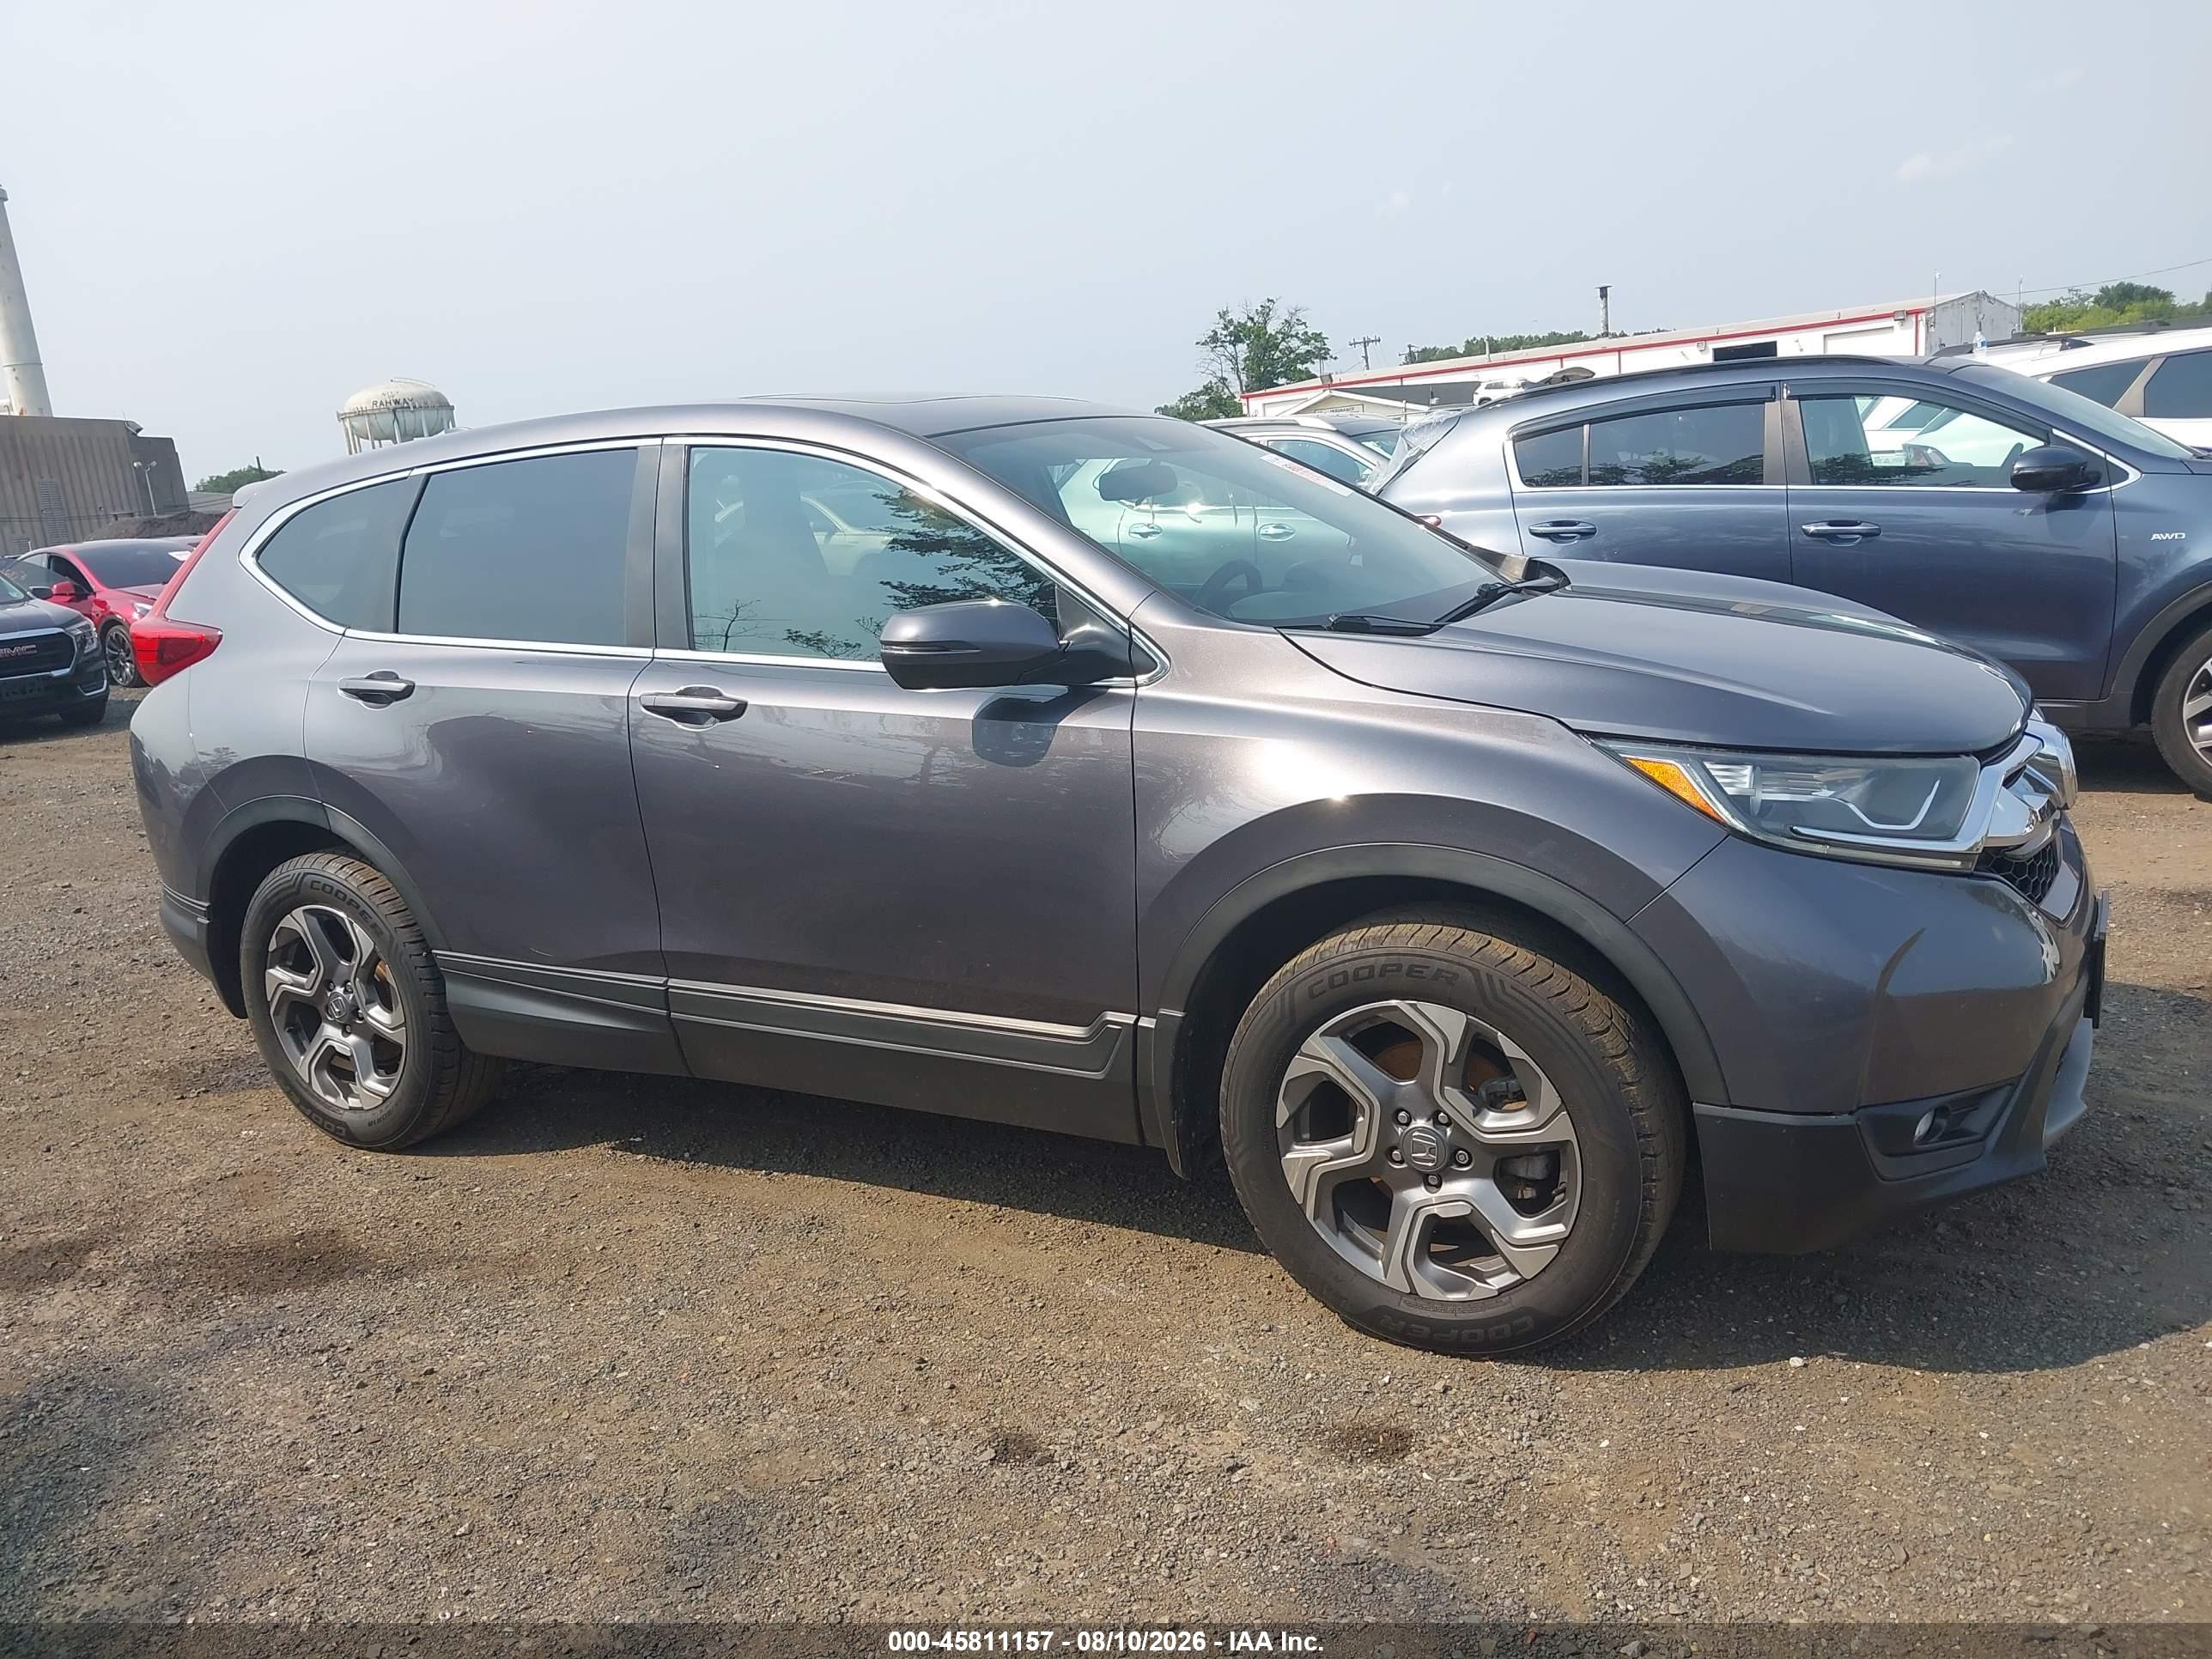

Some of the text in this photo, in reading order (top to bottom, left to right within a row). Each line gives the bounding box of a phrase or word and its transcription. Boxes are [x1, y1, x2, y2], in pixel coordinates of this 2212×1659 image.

[372, 398, 414, 409] RAHWAY
[2150, 532, 2185, 541] AWD
[0, 644, 38, 658] MC
[310, 879, 384, 936] COOPER
[1307, 963, 1460, 1000] COOPER
